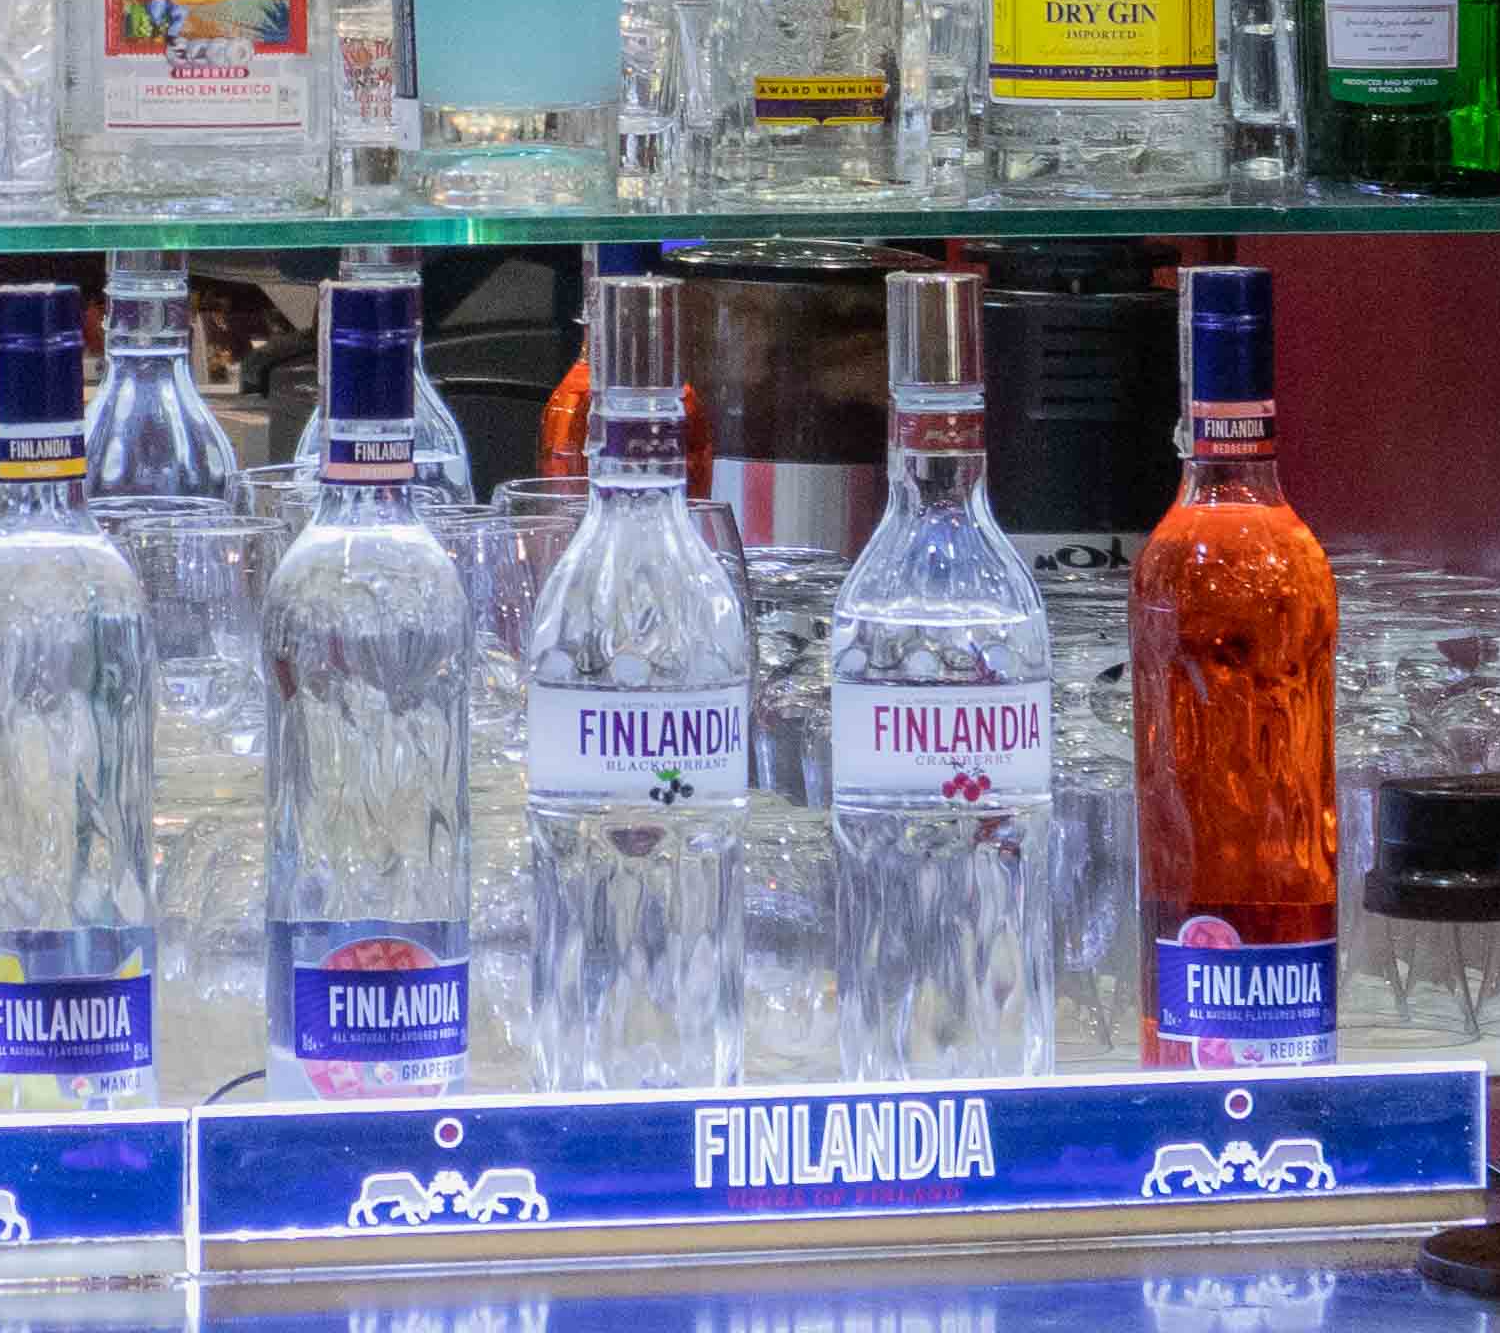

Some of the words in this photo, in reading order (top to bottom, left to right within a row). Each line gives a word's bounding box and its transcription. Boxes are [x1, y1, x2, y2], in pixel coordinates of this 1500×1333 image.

[1045, 1, 1102, 24] DRY
[1107, 2, 1158, 24] GIN
[1065, 29, 1138, 41] IMPORTED
[173, 68, 247, 78] IMPORTED
[145, 84, 195, 95] HECHO
[199, 84, 217, 95] EN
[221, 84, 272, 95] MEXICO
[758, 83, 815, 96] AWARD
[818, 83, 884, 96] WINNING
[1202, 417, 1266, 440] FINLANDIA
[9, 438, 73, 459] FINLANDIA
[353, 441, 411, 462] FINLANDIA
[578, 707, 742, 757] FINLANDIA
[872, 703, 1042, 753] FINLANDIA
[605, 756, 729, 773] BLACKCURRANT
[914, 753, 1013, 767] CRANBERRY
[1186, 961, 1323, 1007] FINLANDIA
[328, 982, 461, 1030] FINLANDIA
[1269, 1038, 1329, 1061] REDBERRY
[100, 1075, 143, 1094] MANGO
[692, 1097, 996, 1189] FINLANDIA
